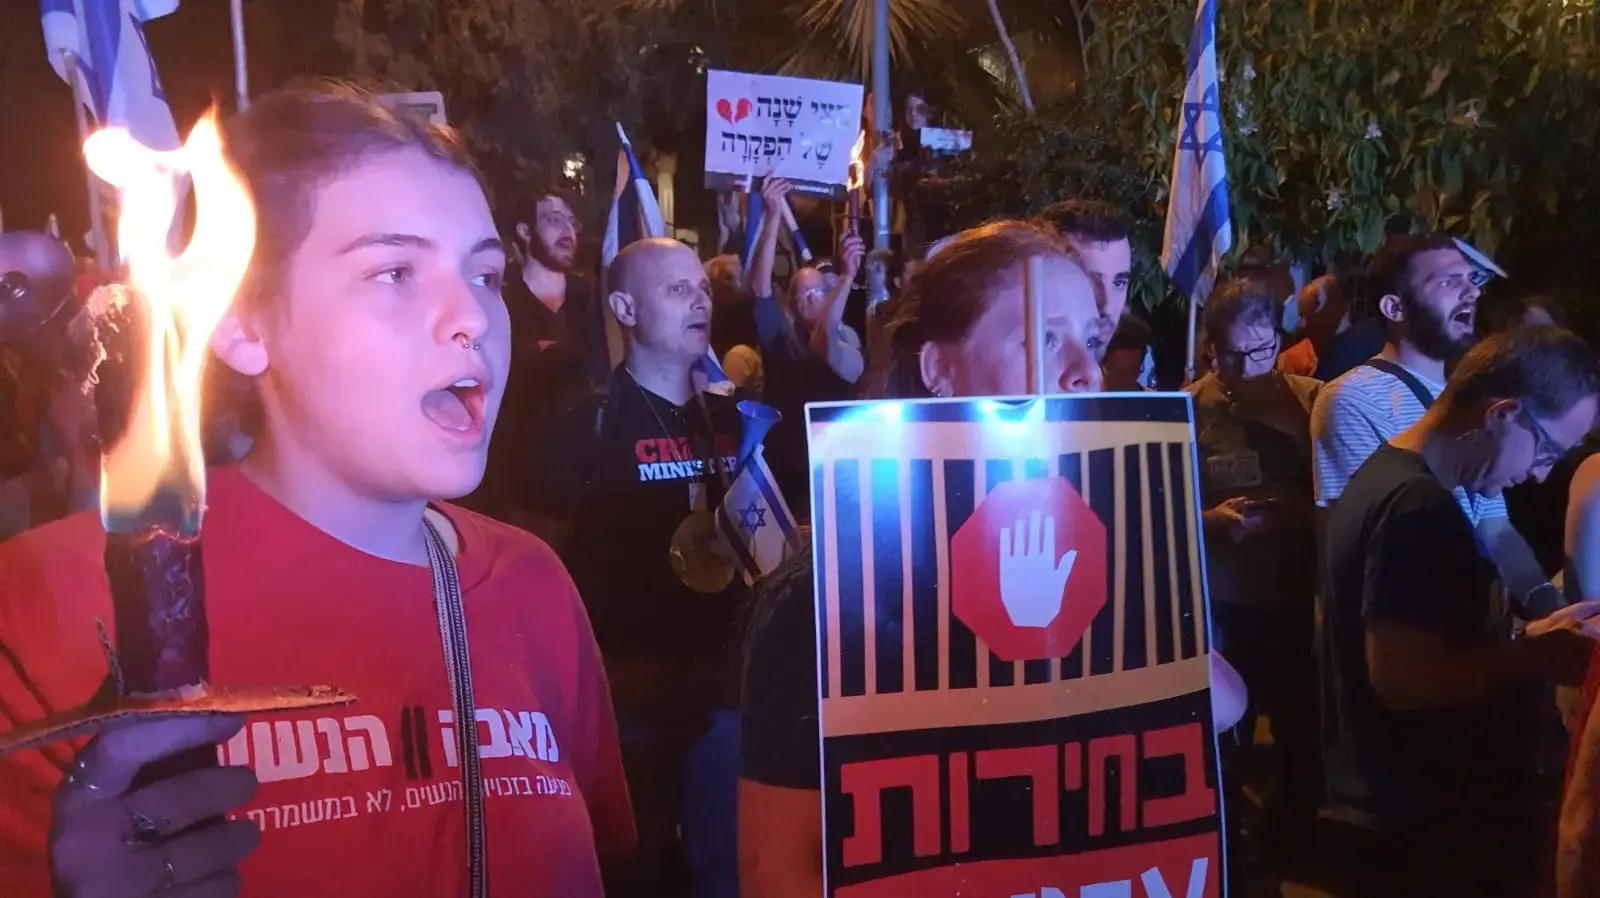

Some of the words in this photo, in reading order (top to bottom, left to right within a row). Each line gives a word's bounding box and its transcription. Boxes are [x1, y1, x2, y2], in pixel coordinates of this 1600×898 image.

[216, 714, 393, 783] הנשי
[365, 789, 392, 813] לא
[483, 776, 533, 797] בזכויו
[840, 722, 1216, 868] בחירות
